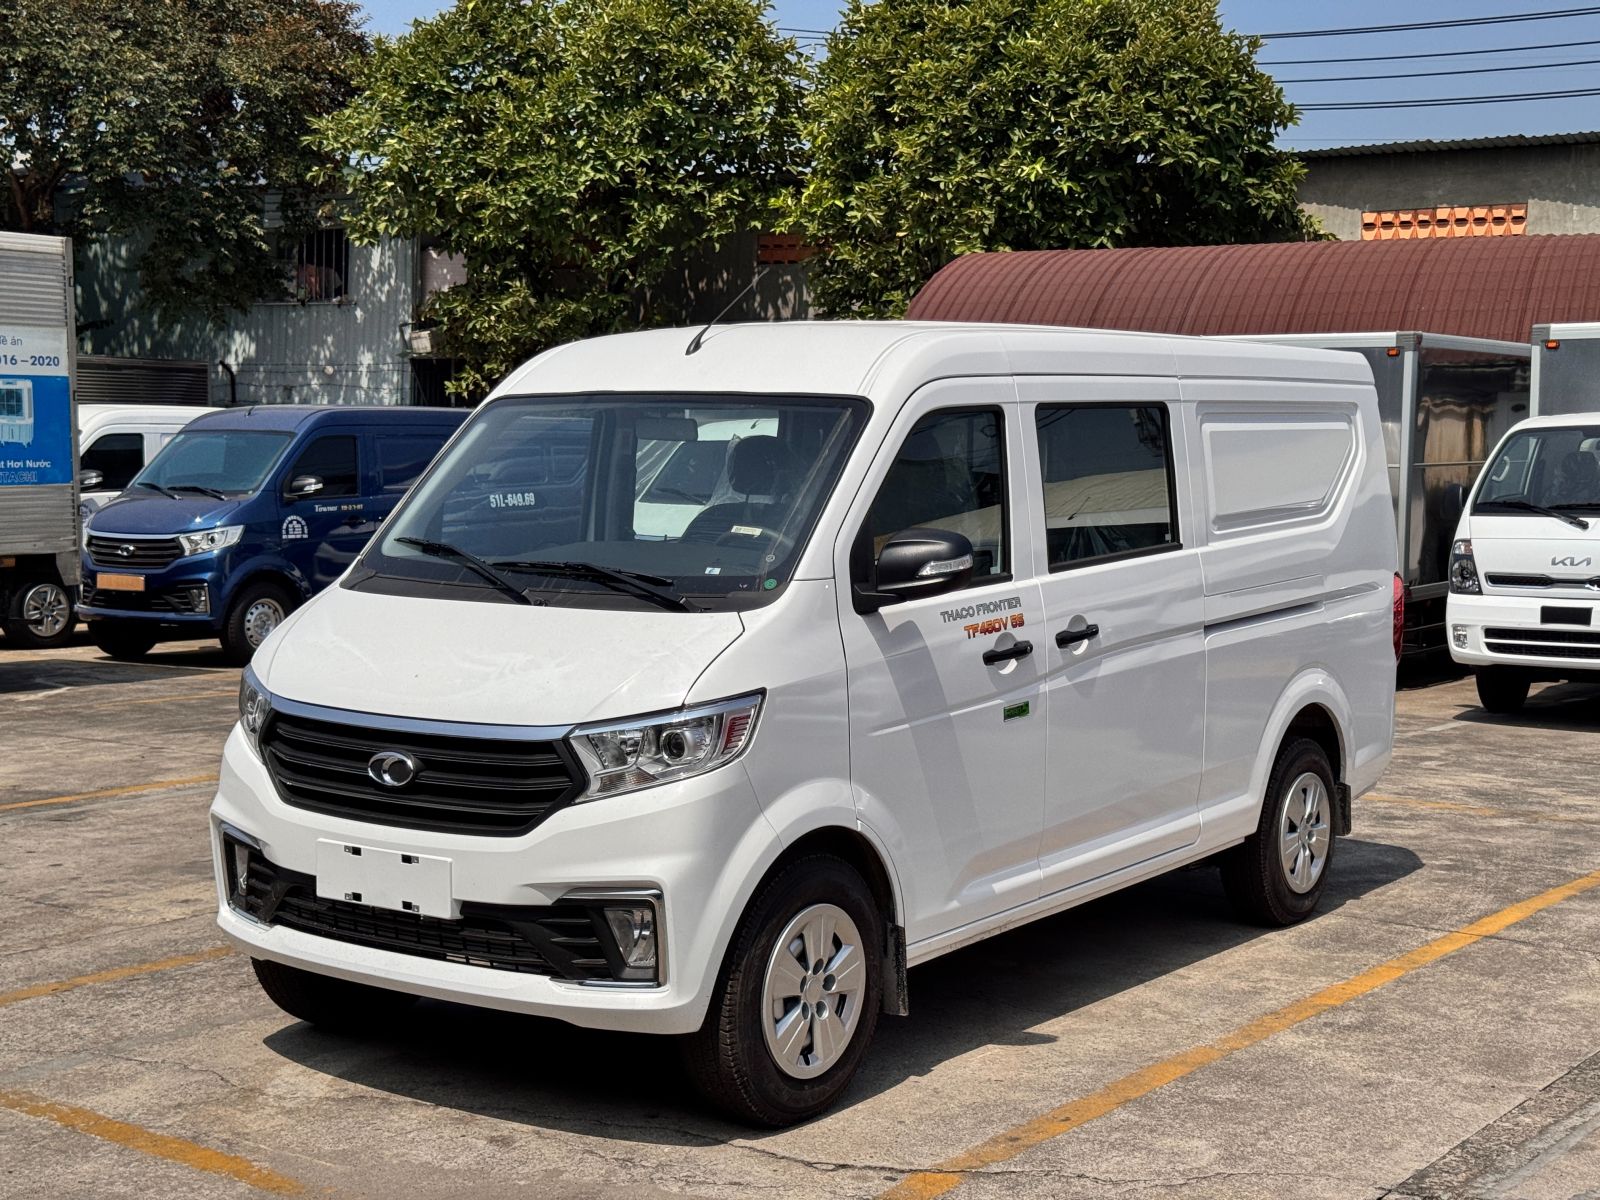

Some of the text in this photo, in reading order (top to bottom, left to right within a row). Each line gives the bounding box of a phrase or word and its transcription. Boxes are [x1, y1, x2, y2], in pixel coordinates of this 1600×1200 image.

[30, 355, 60, 367] 2020
[489, 492, 536, 508] 51L-649.69
[1551, 556, 1592, 567] KIA
[940, 596, 1022, 623] THACO FRONTIER
[963, 616, 1009, 639] TF450V
